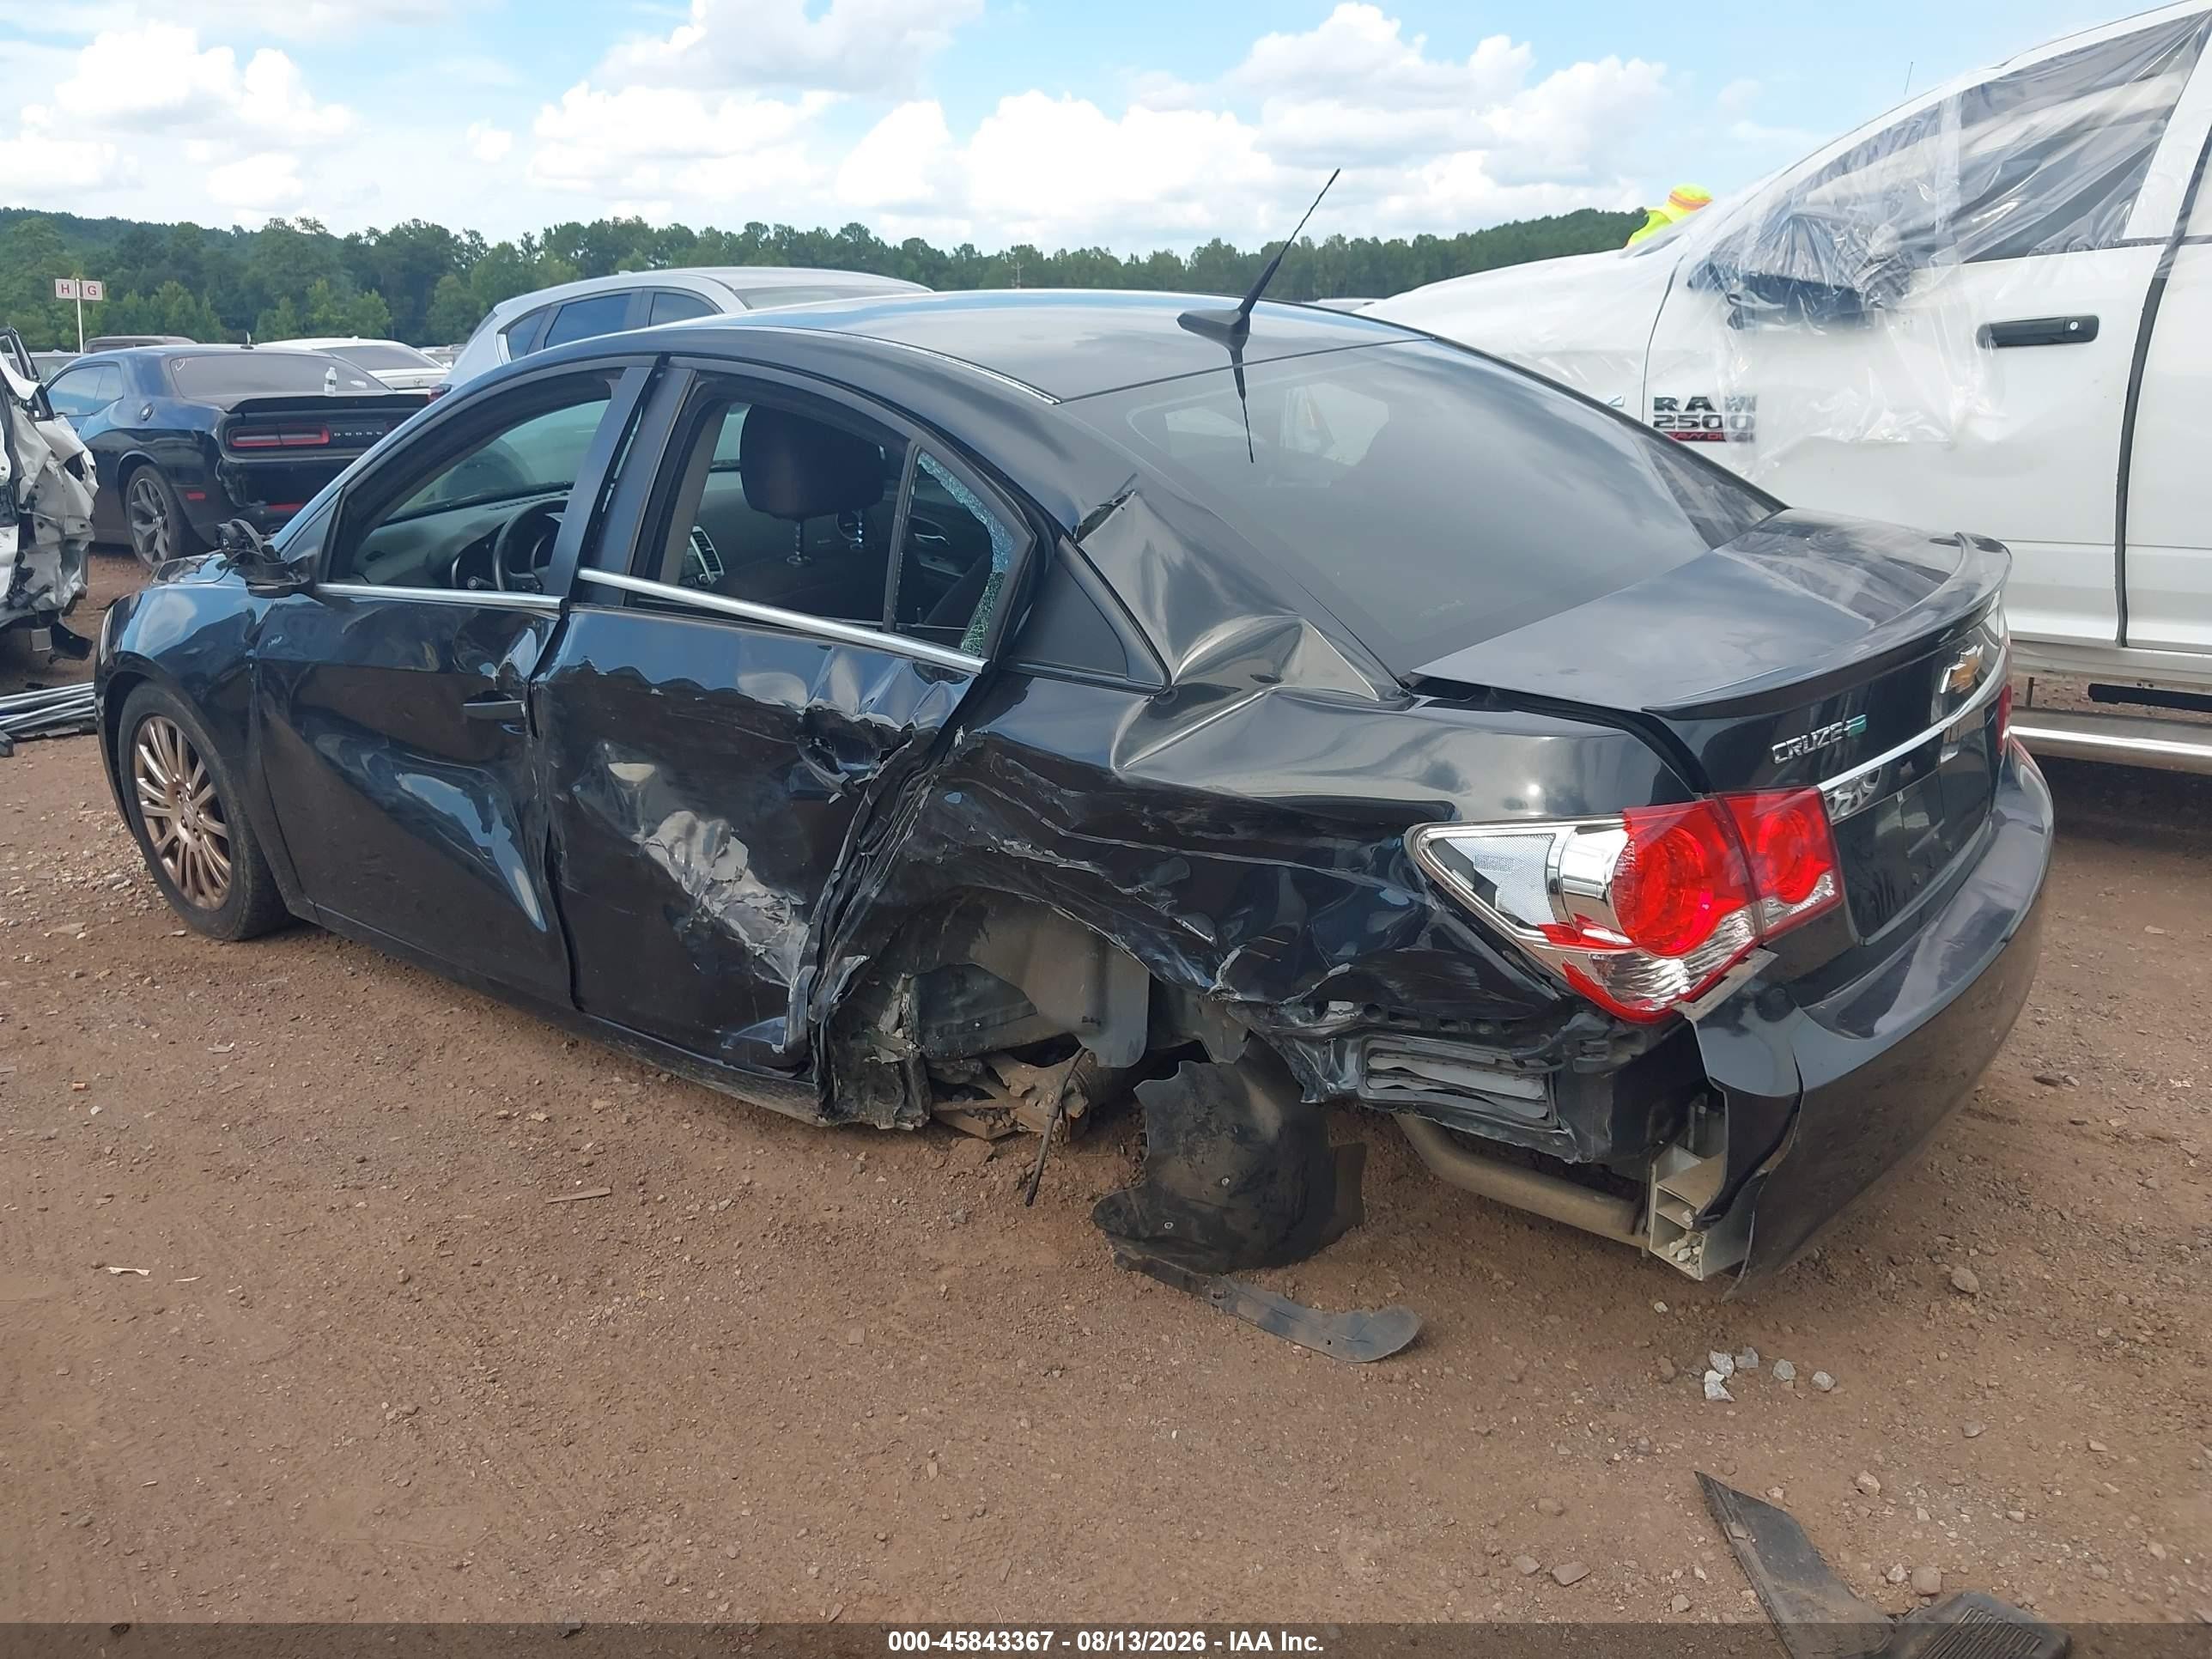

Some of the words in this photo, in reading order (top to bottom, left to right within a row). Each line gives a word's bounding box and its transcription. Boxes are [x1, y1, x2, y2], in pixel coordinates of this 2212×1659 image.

[61, 283, 70, 295] H
[87, 285, 97, 296] G
[1653, 414, 1756, 430] 2500
[1771, 721, 1844, 763] CRUZE
